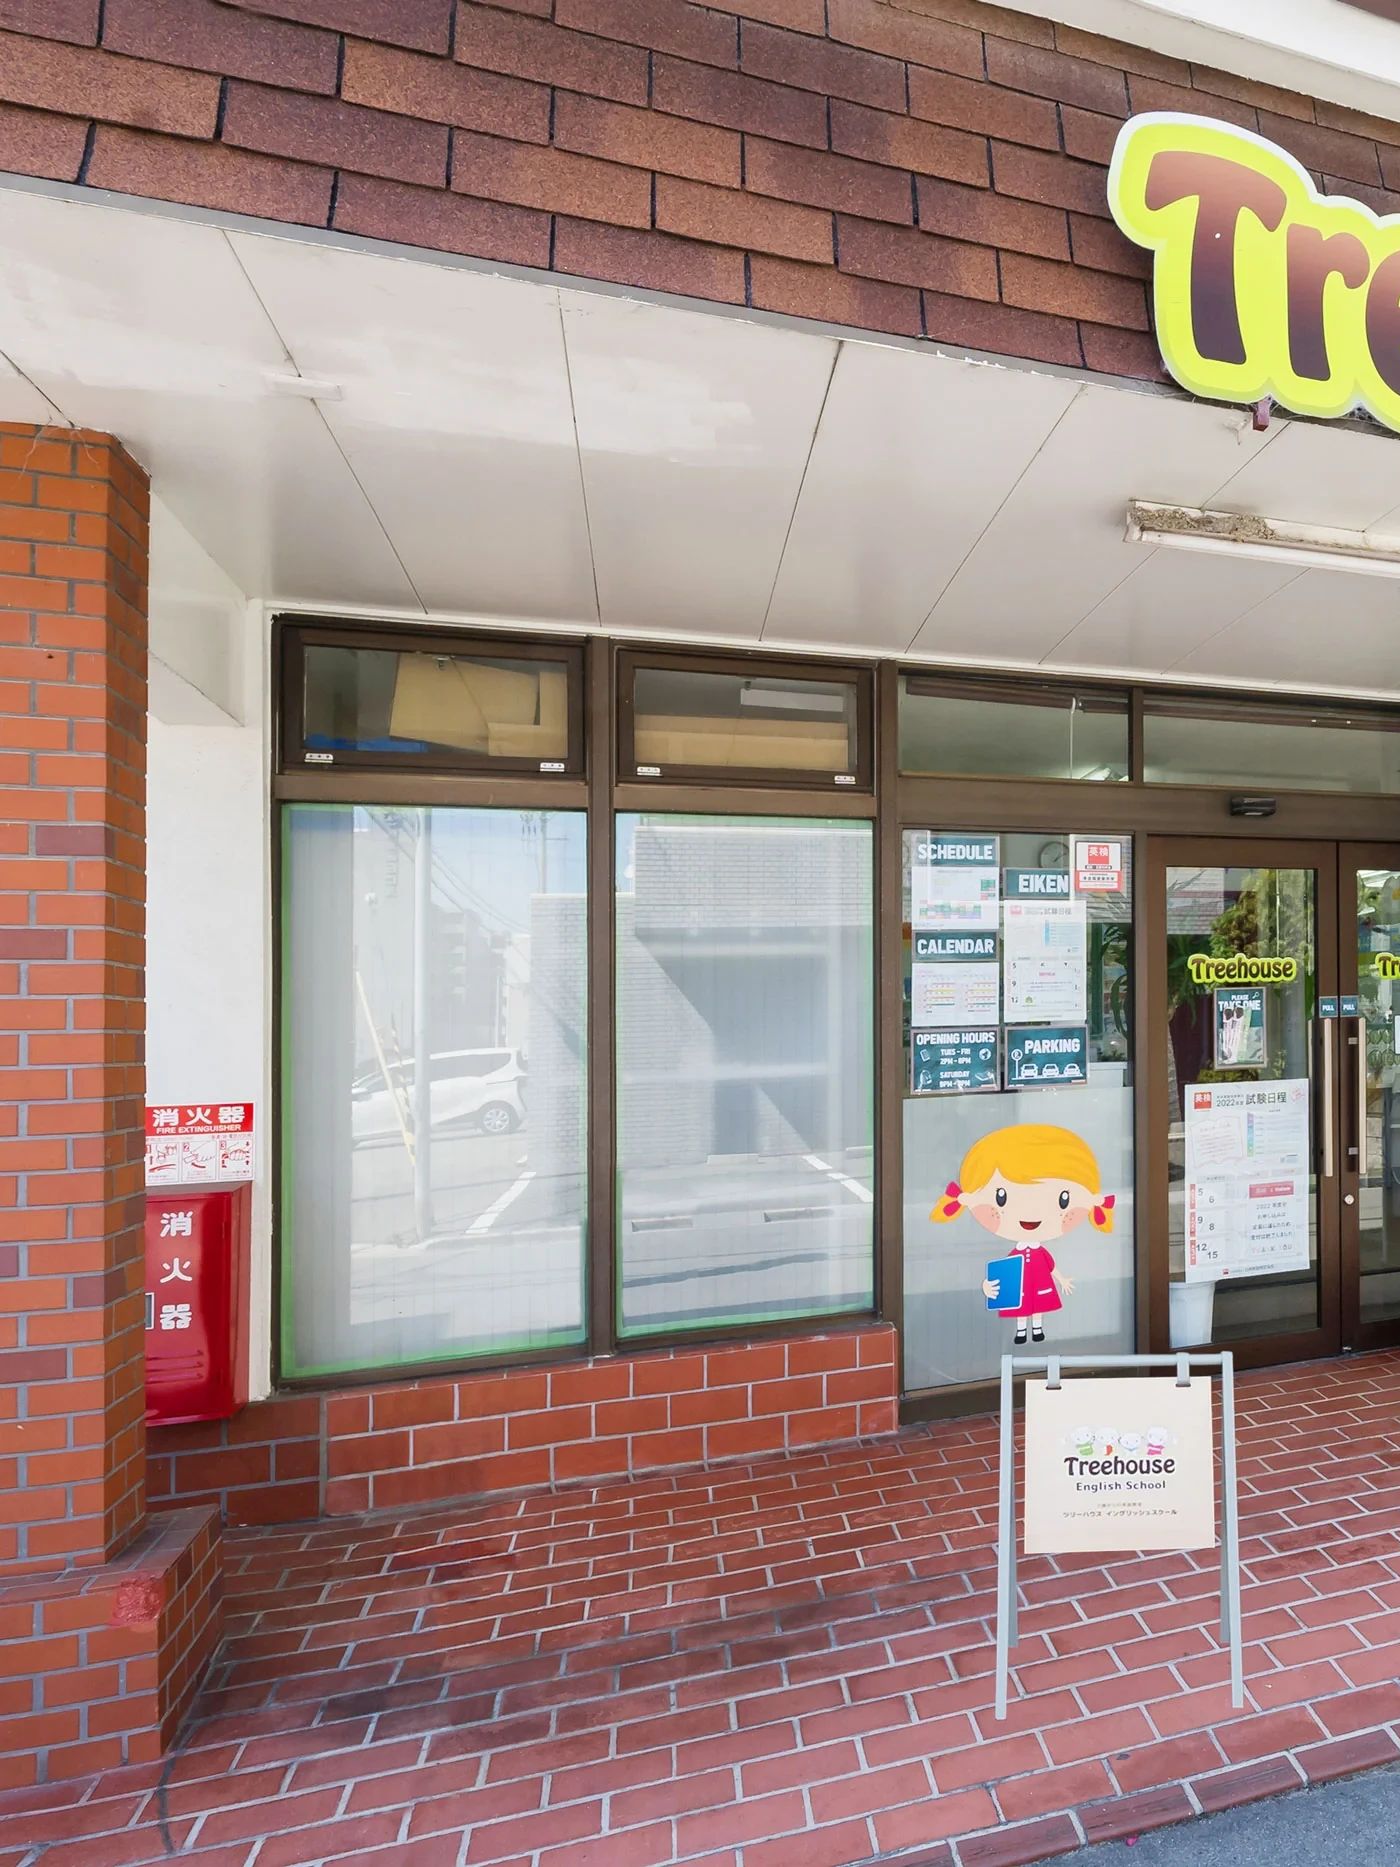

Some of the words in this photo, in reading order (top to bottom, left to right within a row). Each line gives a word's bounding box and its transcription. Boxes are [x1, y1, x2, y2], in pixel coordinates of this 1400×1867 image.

[918, 844, 993, 860] SCHEDULE
[1019, 874, 1069, 893] EIKEN
[917, 939, 994, 955] CALENDAR
[1191, 957, 1294, 980] Treehouse
[1231, 994, 1249, 1002] PLEASE
[1244, 1000, 1261, 1011] ONE
[1322, 1004, 1334, 1012] PULL
[916, 1033, 960, 1046] OPENING
[962, 1032, 996, 1044] HOURS
[1024, 1038, 1081, 1055] PARKING
[1246, 1091, 1287, 1105] 試験日程
[152, 1106, 245, 1127] 消火器
[156, 1126, 177, 1134] FIRE
[178, 1124, 242, 1134] EXTINGUISHER
[1197, 1216, 1204, 1224] 9
[1208, 1223, 1215, 1231] 8
[1196, 1243, 1207, 1252] 12
[1208, 1251, 1218, 1259] 15
[160, 1211, 193, 1330] 消火器
[1064, 1456, 1176, 1476] Treehouse
[1076, 1482, 1122, 1493] English
[1126, 1480, 1166, 1490] School
[1106, 1509, 1177, 1517] イングリッシュスクール
